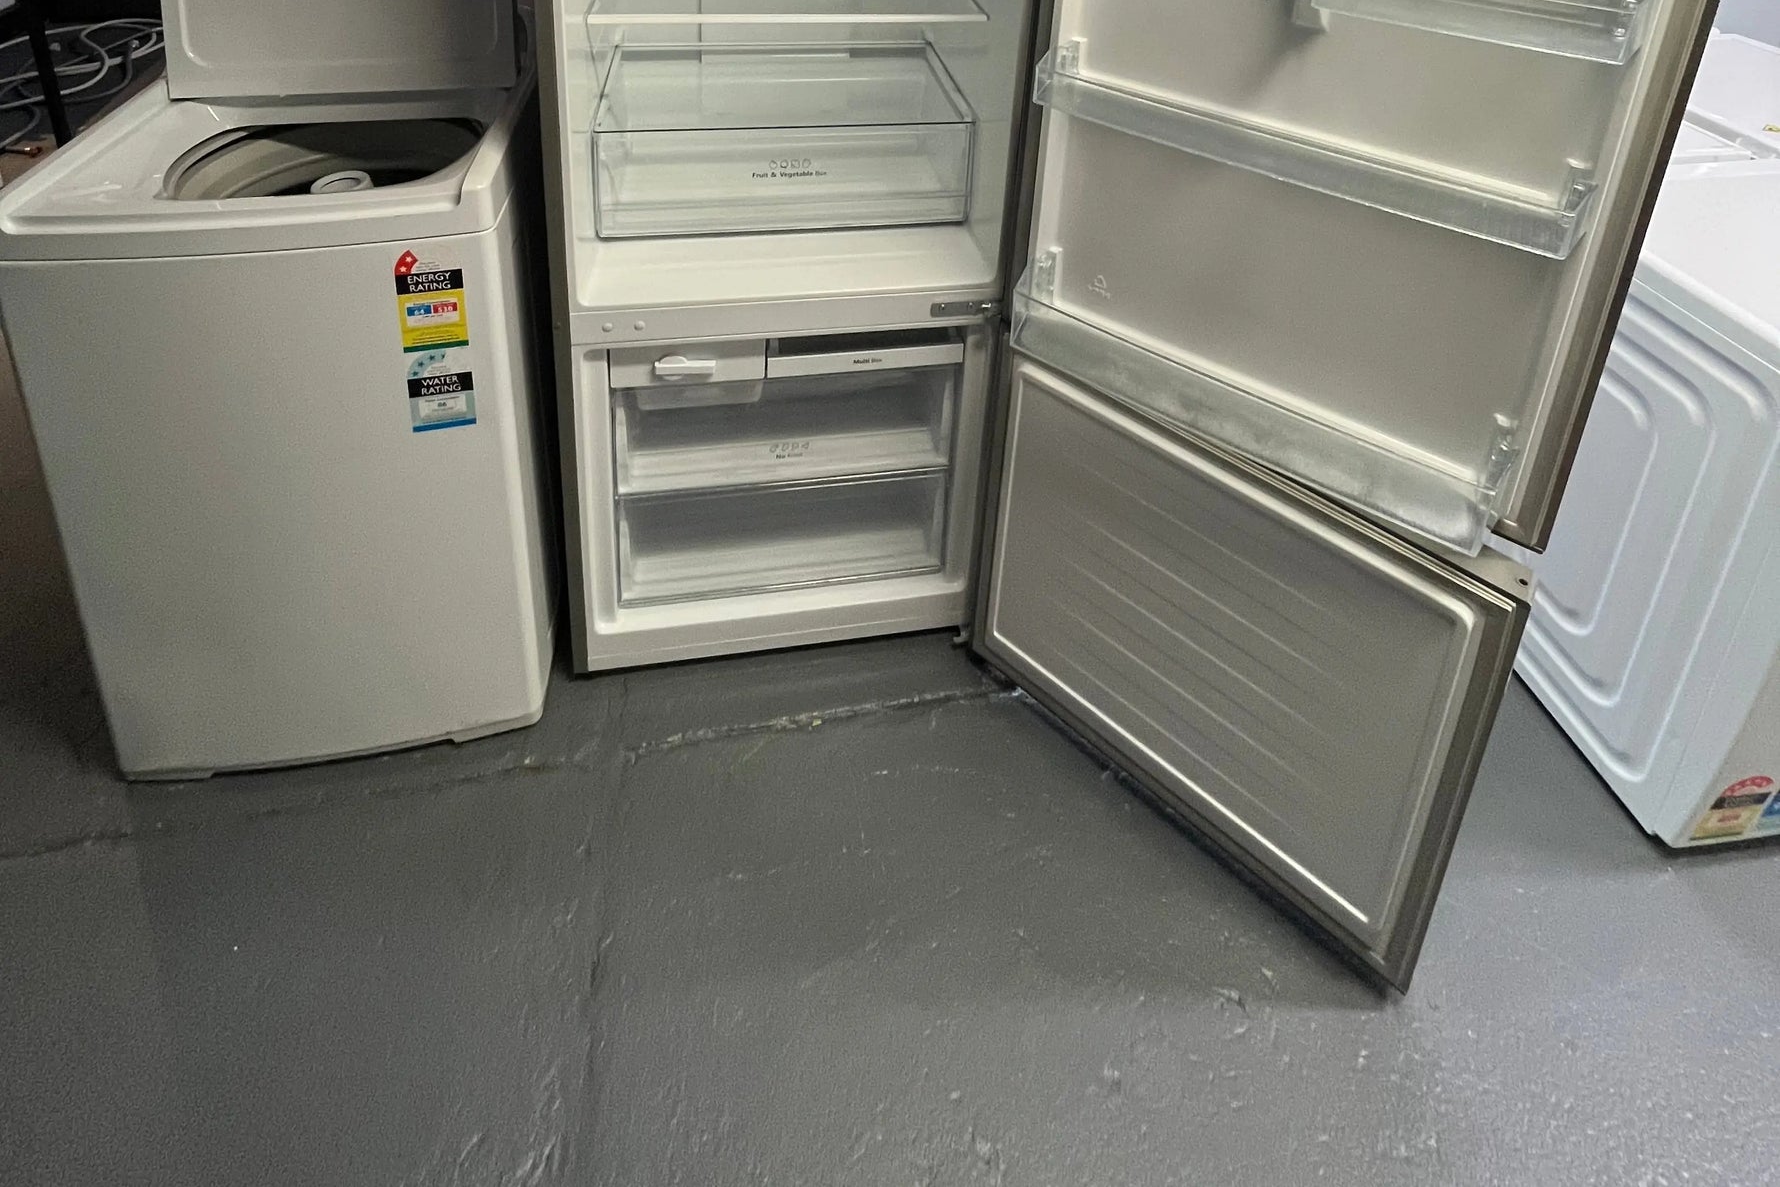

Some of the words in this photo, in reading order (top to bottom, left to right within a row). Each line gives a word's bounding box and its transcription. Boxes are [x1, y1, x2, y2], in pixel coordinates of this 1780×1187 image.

[779, 170, 814, 178] Vegetable
[407, 271, 451, 284] ENERGY
[409, 281, 451, 292] RATING
[421, 375, 459, 386] WATER
[421, 384, 461, 395] RATING
